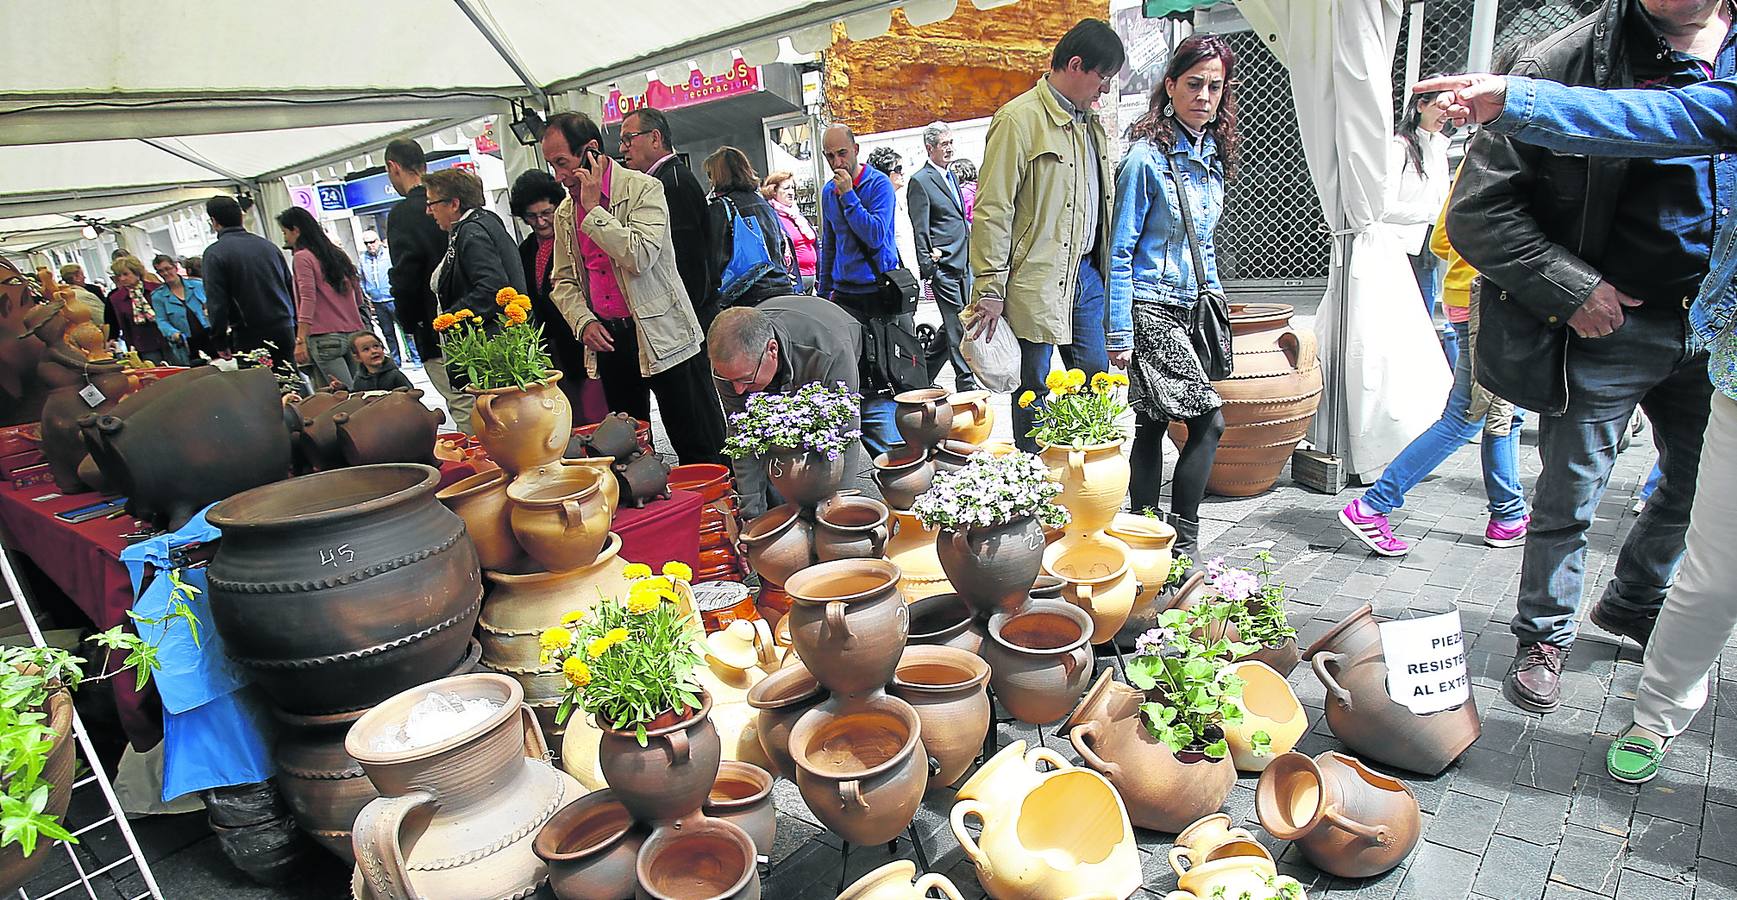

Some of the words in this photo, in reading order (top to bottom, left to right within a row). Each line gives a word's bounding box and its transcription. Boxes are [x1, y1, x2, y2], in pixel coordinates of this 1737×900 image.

[321, 190, 338, 202] 24
[1022, 526, 1045, 550] 25
[319, 543, 355, 568] 45
[1431, 631, 1463, 649] PIEZ
[1407, 652, 1466, 675] RESISTE
[1413, 684, 1434, 697] AL
